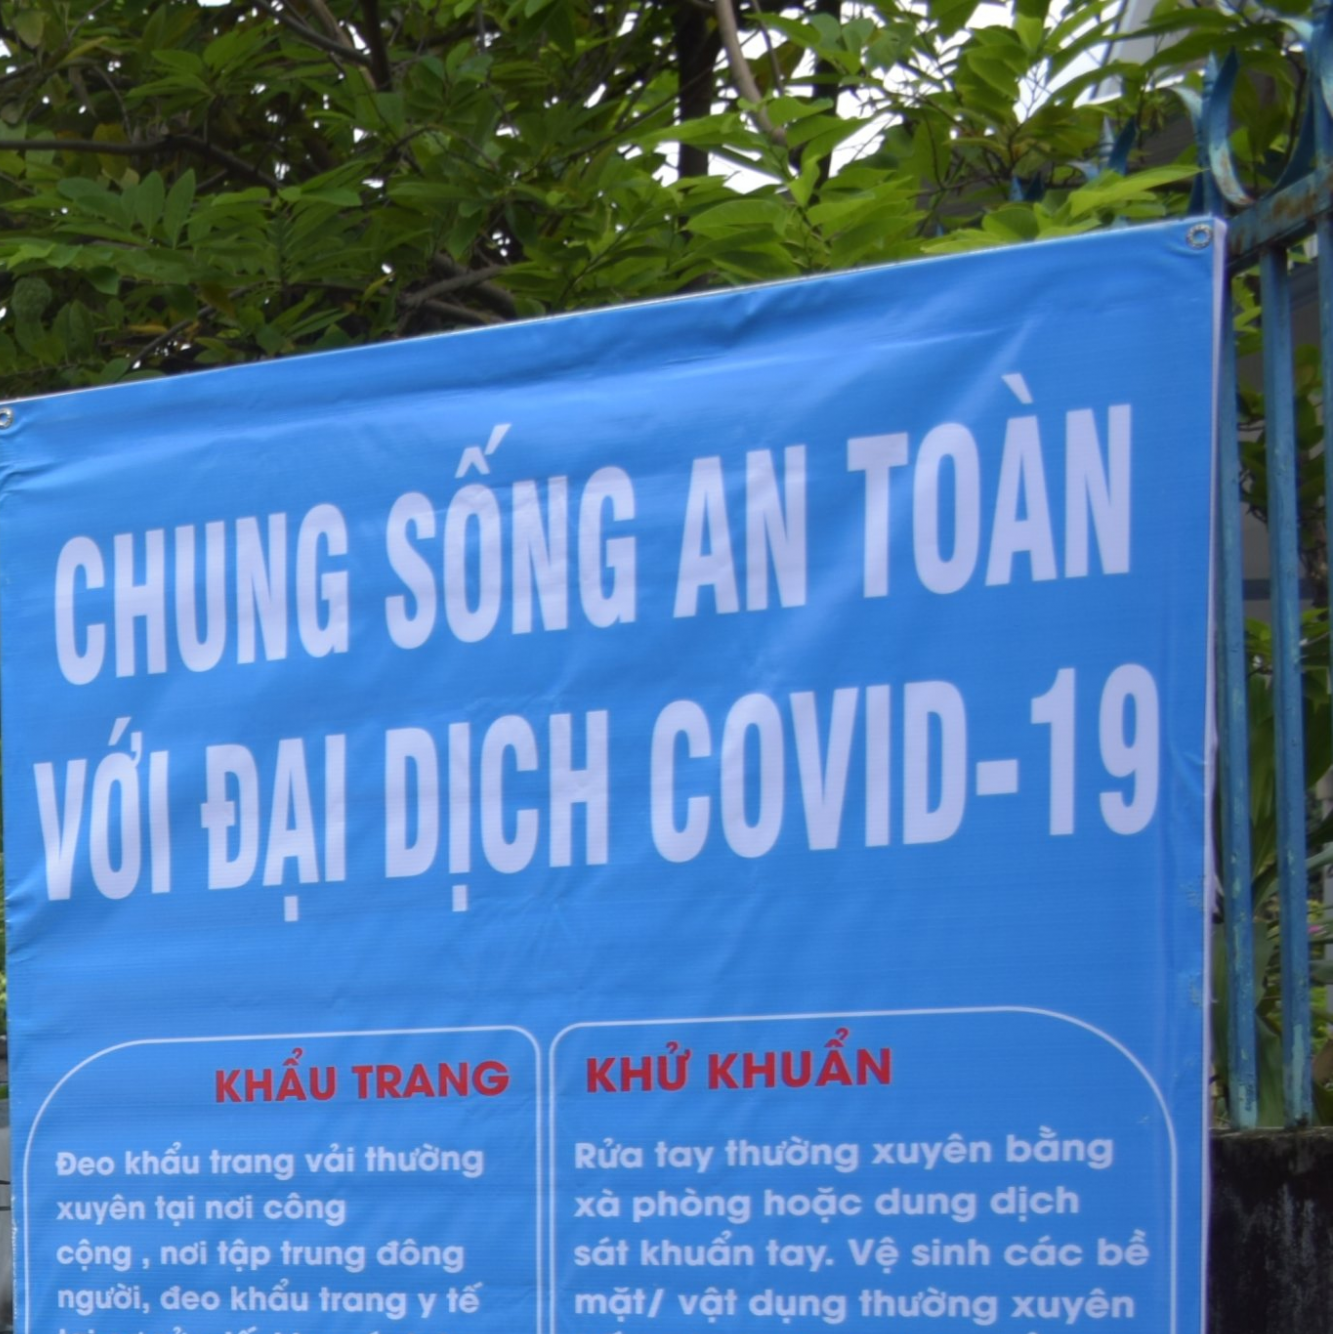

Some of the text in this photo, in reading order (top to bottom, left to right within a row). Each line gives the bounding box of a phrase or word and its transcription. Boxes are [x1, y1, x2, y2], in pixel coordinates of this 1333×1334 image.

[54, 372, 1132, 686] CHUNG SỐNG AN TOÀN
[33, 663, 1160, 922] VỚI ĐẠI DỊCH COVID-19
[215, 1047, 510, 1103] KHẨU TRANG
[587, 1027, 892, 1093] KHỬ KHUẨN
[55, 1141, 485, 1181] Đeo khẩu trang vải thường
[574, 1125, 1114, 1174] Rửa tay thường xuyên bằng
[56, 1191, 347, 1228] xuyên tại nơi công
[574, 1185, 1080, 1225] xà phòng hoặc dung dịch
[56, 1237, 465, 1274] cộng nơi tập trung đông
[573, 1228, 1151, 1274] sát khuẩn tay. Vệ sinh các bề
[57, 1277, 483, 1321] người, đeo khẩu trang y tế
[677, 1286, 738, 1324] vật
[748, 1288, 848, 1325] dụng
[858, 1287, 999, 1326] thường
[1011, 1287, 1135, 1325] xuyên
